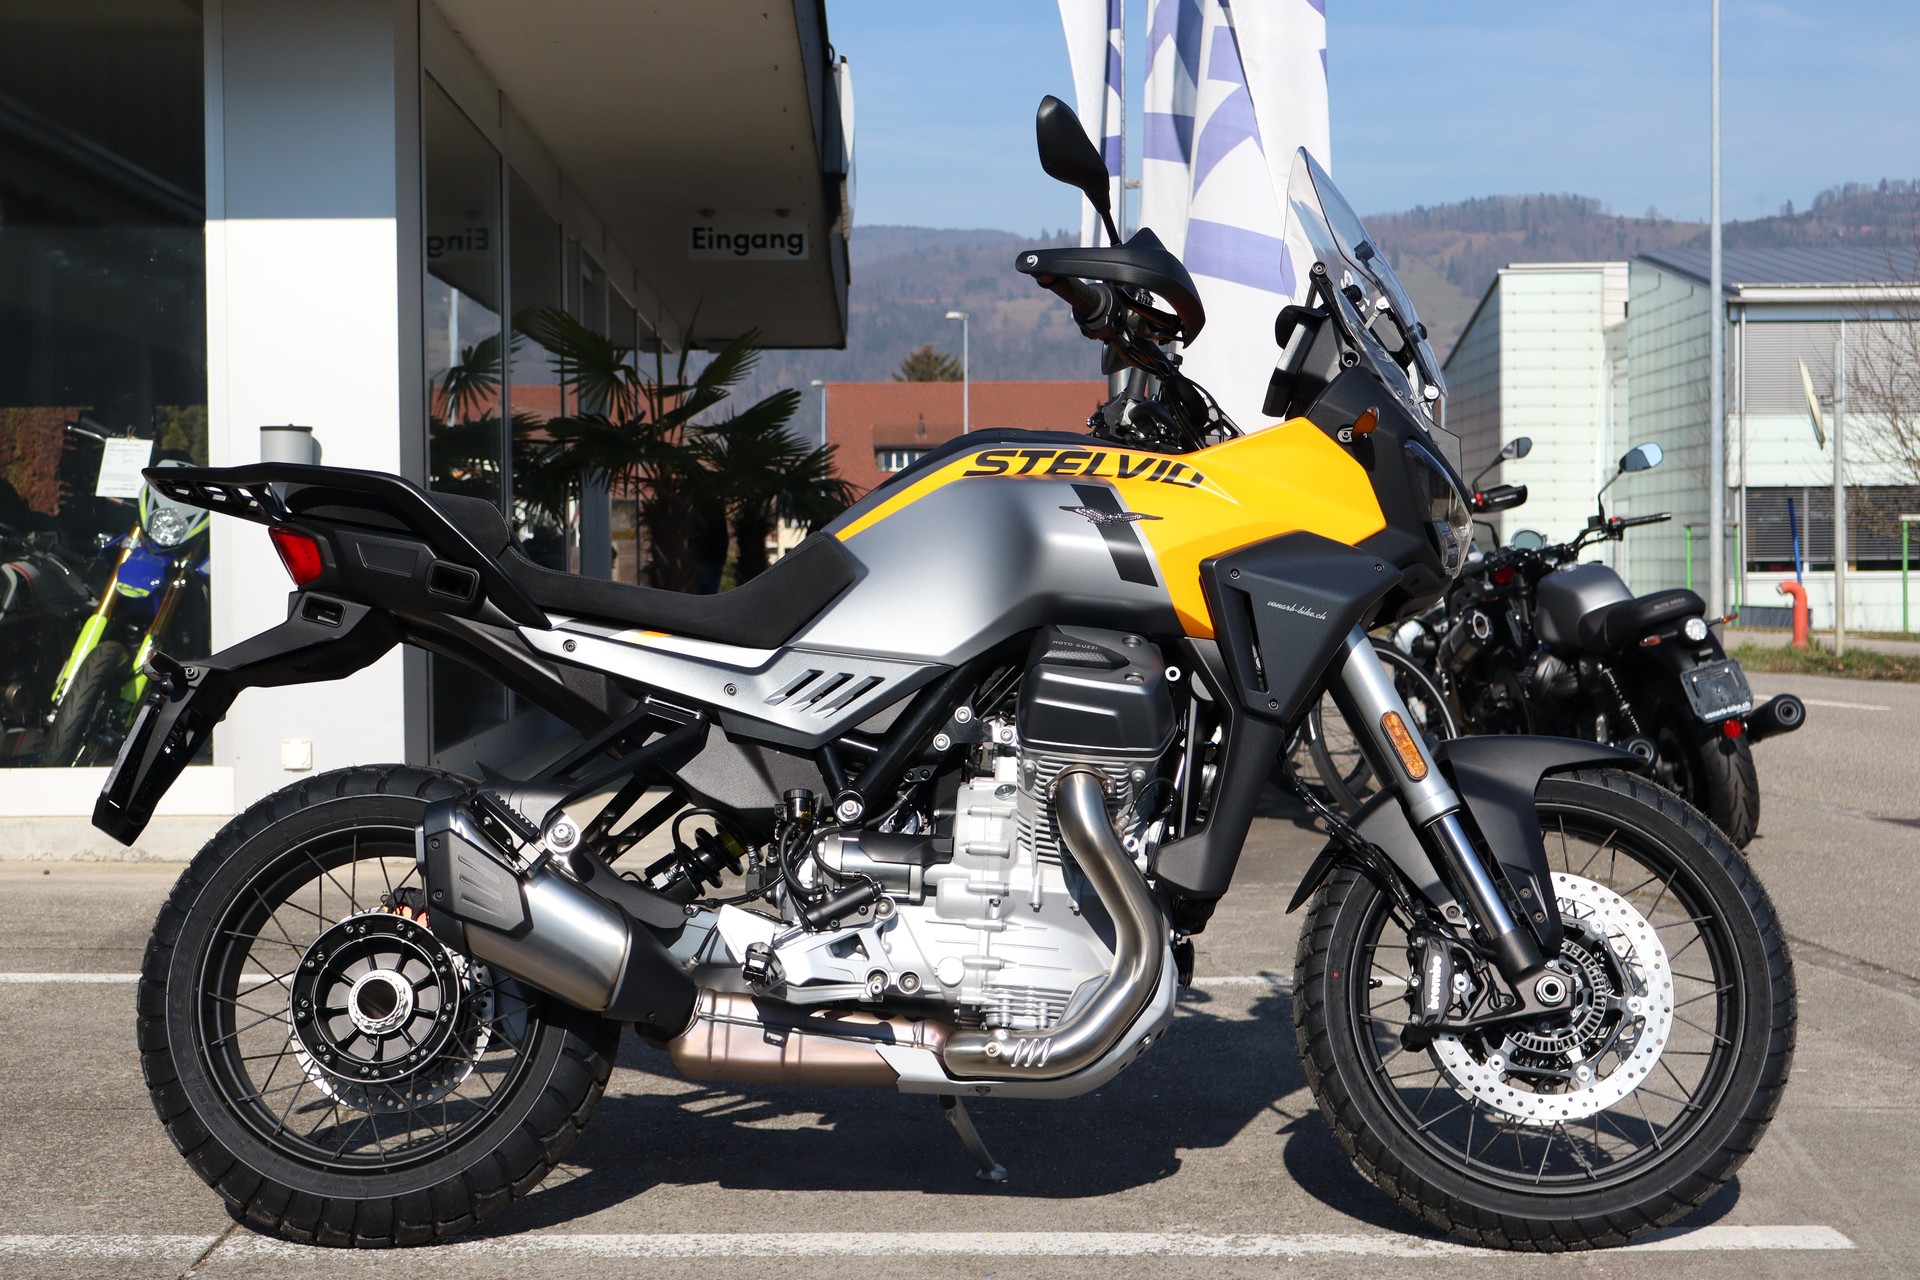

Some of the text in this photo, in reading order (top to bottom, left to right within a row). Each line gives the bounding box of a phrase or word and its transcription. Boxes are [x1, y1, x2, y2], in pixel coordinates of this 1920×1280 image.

[692, 226, 804, 256] Eingang
[962, 449, 1205, 488] STELVIO
[1267, 600, 1328, 620] vonarb-bike.ch
[1427, 955, 1442, 1009] brembo
